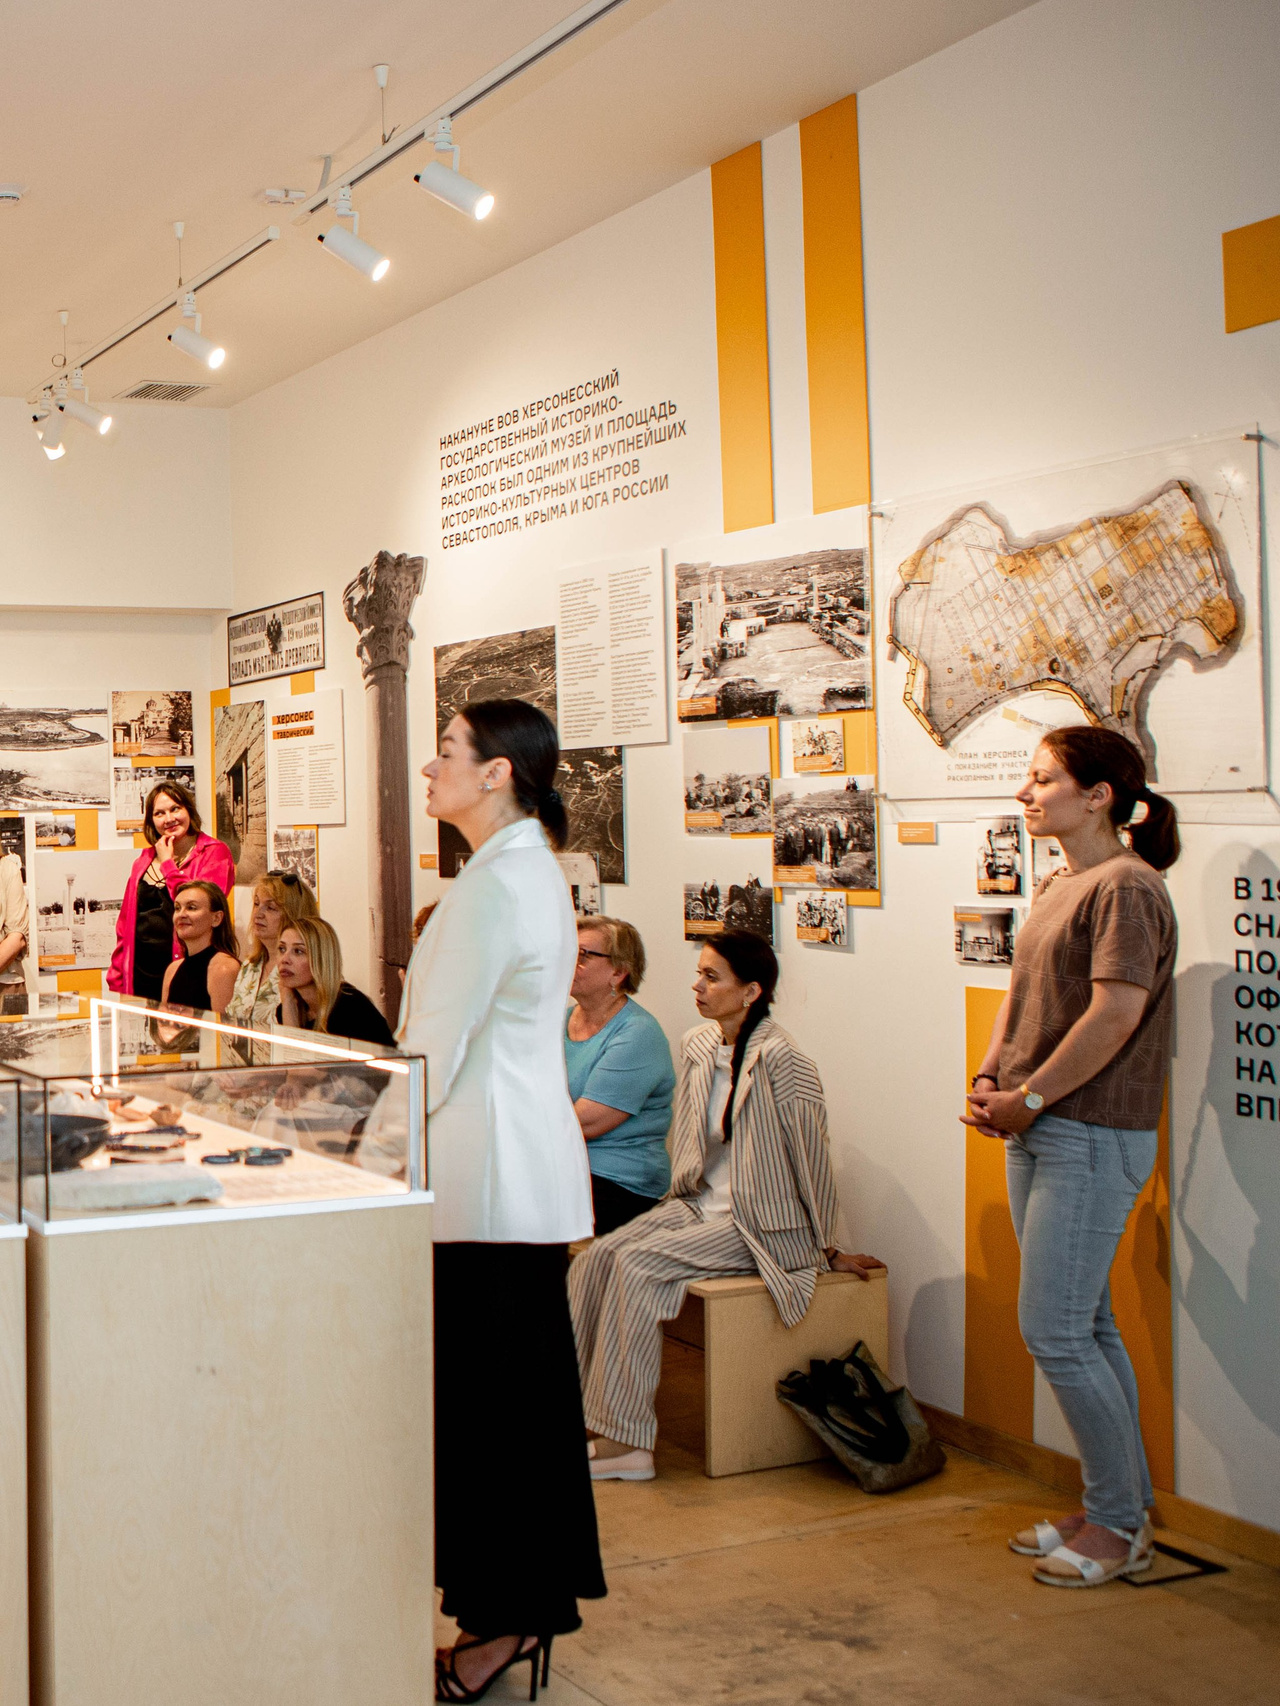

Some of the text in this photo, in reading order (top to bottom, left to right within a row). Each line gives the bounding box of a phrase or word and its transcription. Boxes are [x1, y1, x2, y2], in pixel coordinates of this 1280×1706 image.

[439, 368, 619, 450] НАКАНУНЕ ВОВ ХЕРСОНЕССКИЙ
[440, 395, 623, 470] ГОСУДАРСТВЕННЫЙ ИСТОРИКО-
[440, 400, 677, 490] АРХЕОЛОГИЧЕСКИЙ МУЗЕЙ И ПЛОЩАДЬ
[441, 420, 687, 510] РАСКОПОК БЫЛ ОДНИМ ИЗ КРУПНЕЙШИХ
[441, 458, 640, 530] ИСТОРИКО-КУЛЬТУРНЫХ ЦЕНТРОВ
[442, 474, 669, 549] СЕВАСТОПОЛЯ, КРЫМА И ЮГА РОССИИ
[954, 762, 998, 770] ПОКАЗАНИЕМ
[1001, 760, 1031, 768] УЧАСТКО
[983, 750, 1028, 759] ХЕРСОНЕСА
[947, 774, 995, 782] РАСКОПАННЫХ
[1234, 877, 1252, 900] В
[1234, 949, 1280, 981] ПО
[1234, 984, 1280, 1012] ОФ
[1235, 1020, 1280, 1048] КО
[1235, 1056, 1277, 1085] НА
[1235, 1092, 1280, 1121] ВП
